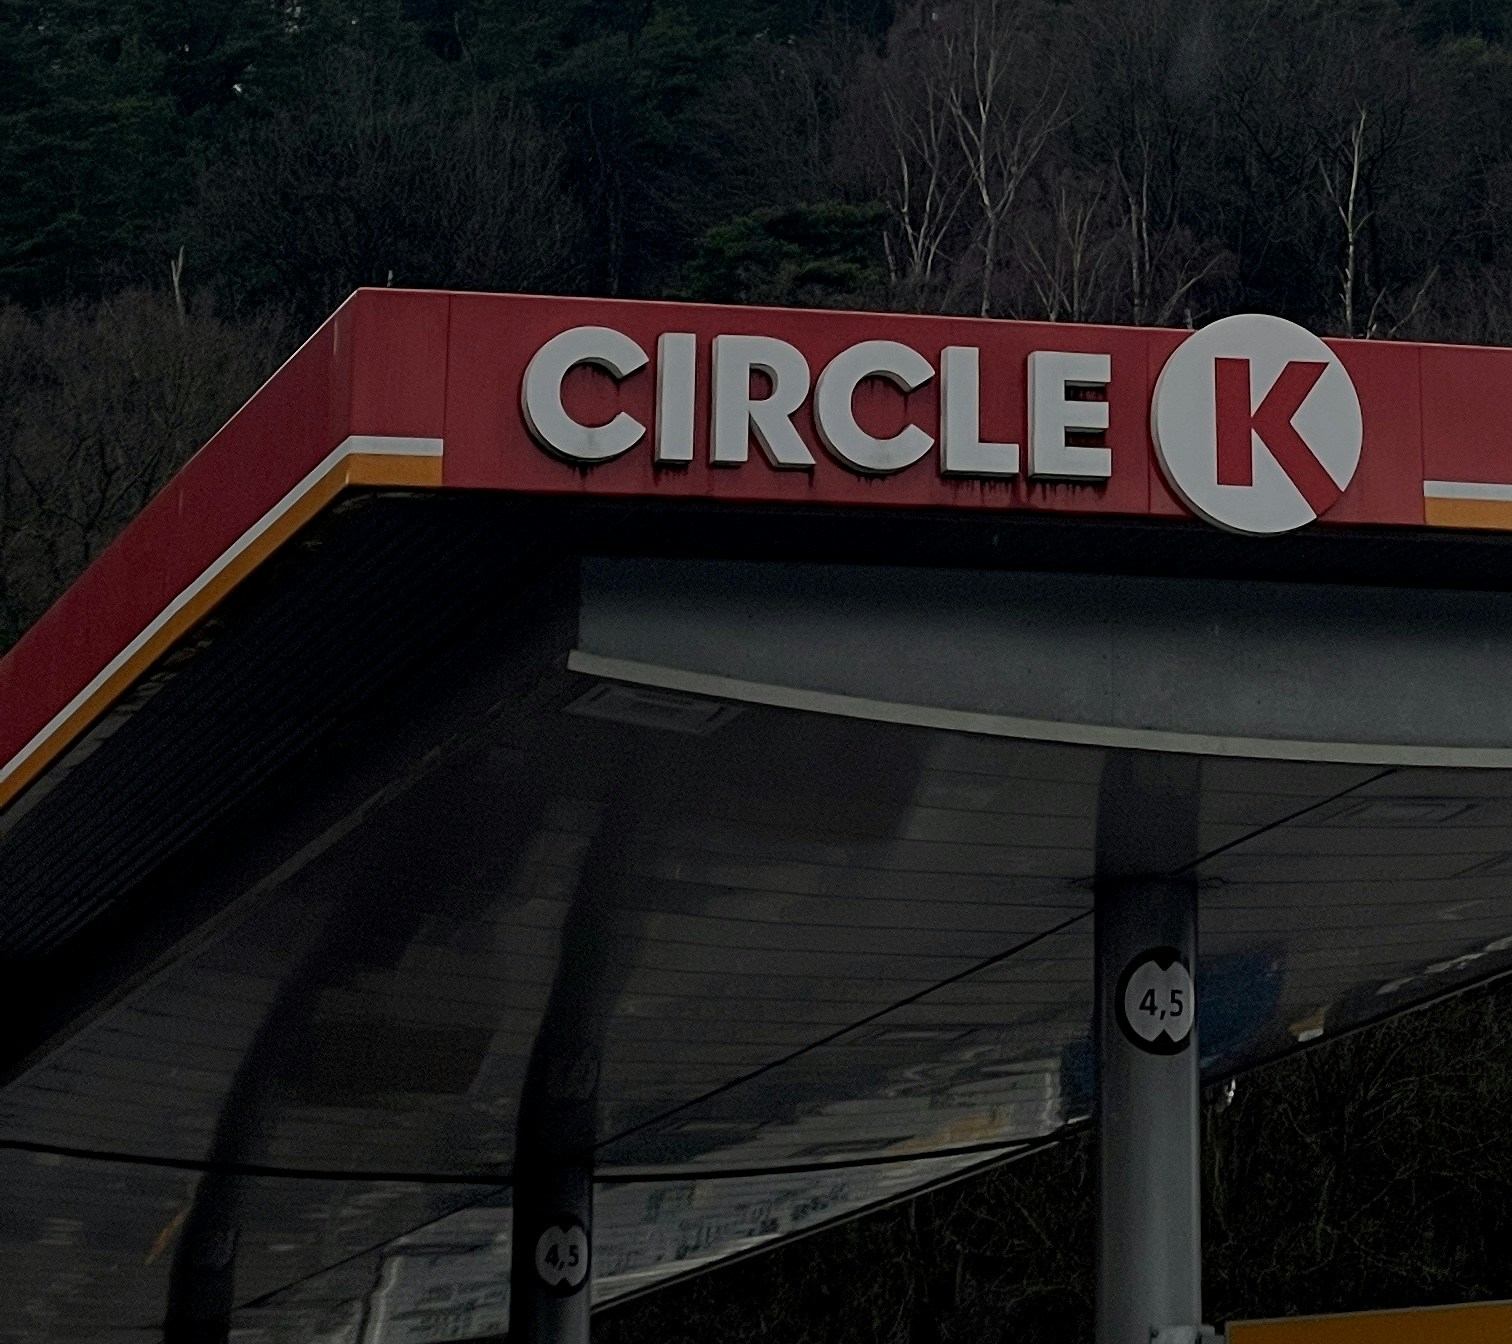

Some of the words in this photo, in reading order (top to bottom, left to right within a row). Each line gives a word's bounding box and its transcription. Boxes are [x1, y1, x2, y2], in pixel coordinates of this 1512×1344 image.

[521, 325, 1113, 482] CIRCLE
[1214, 357, 1345, 521] K
[1139, 988, 1183, 1020] 4,5
[545, 1244, 579, 1270] 4,5
